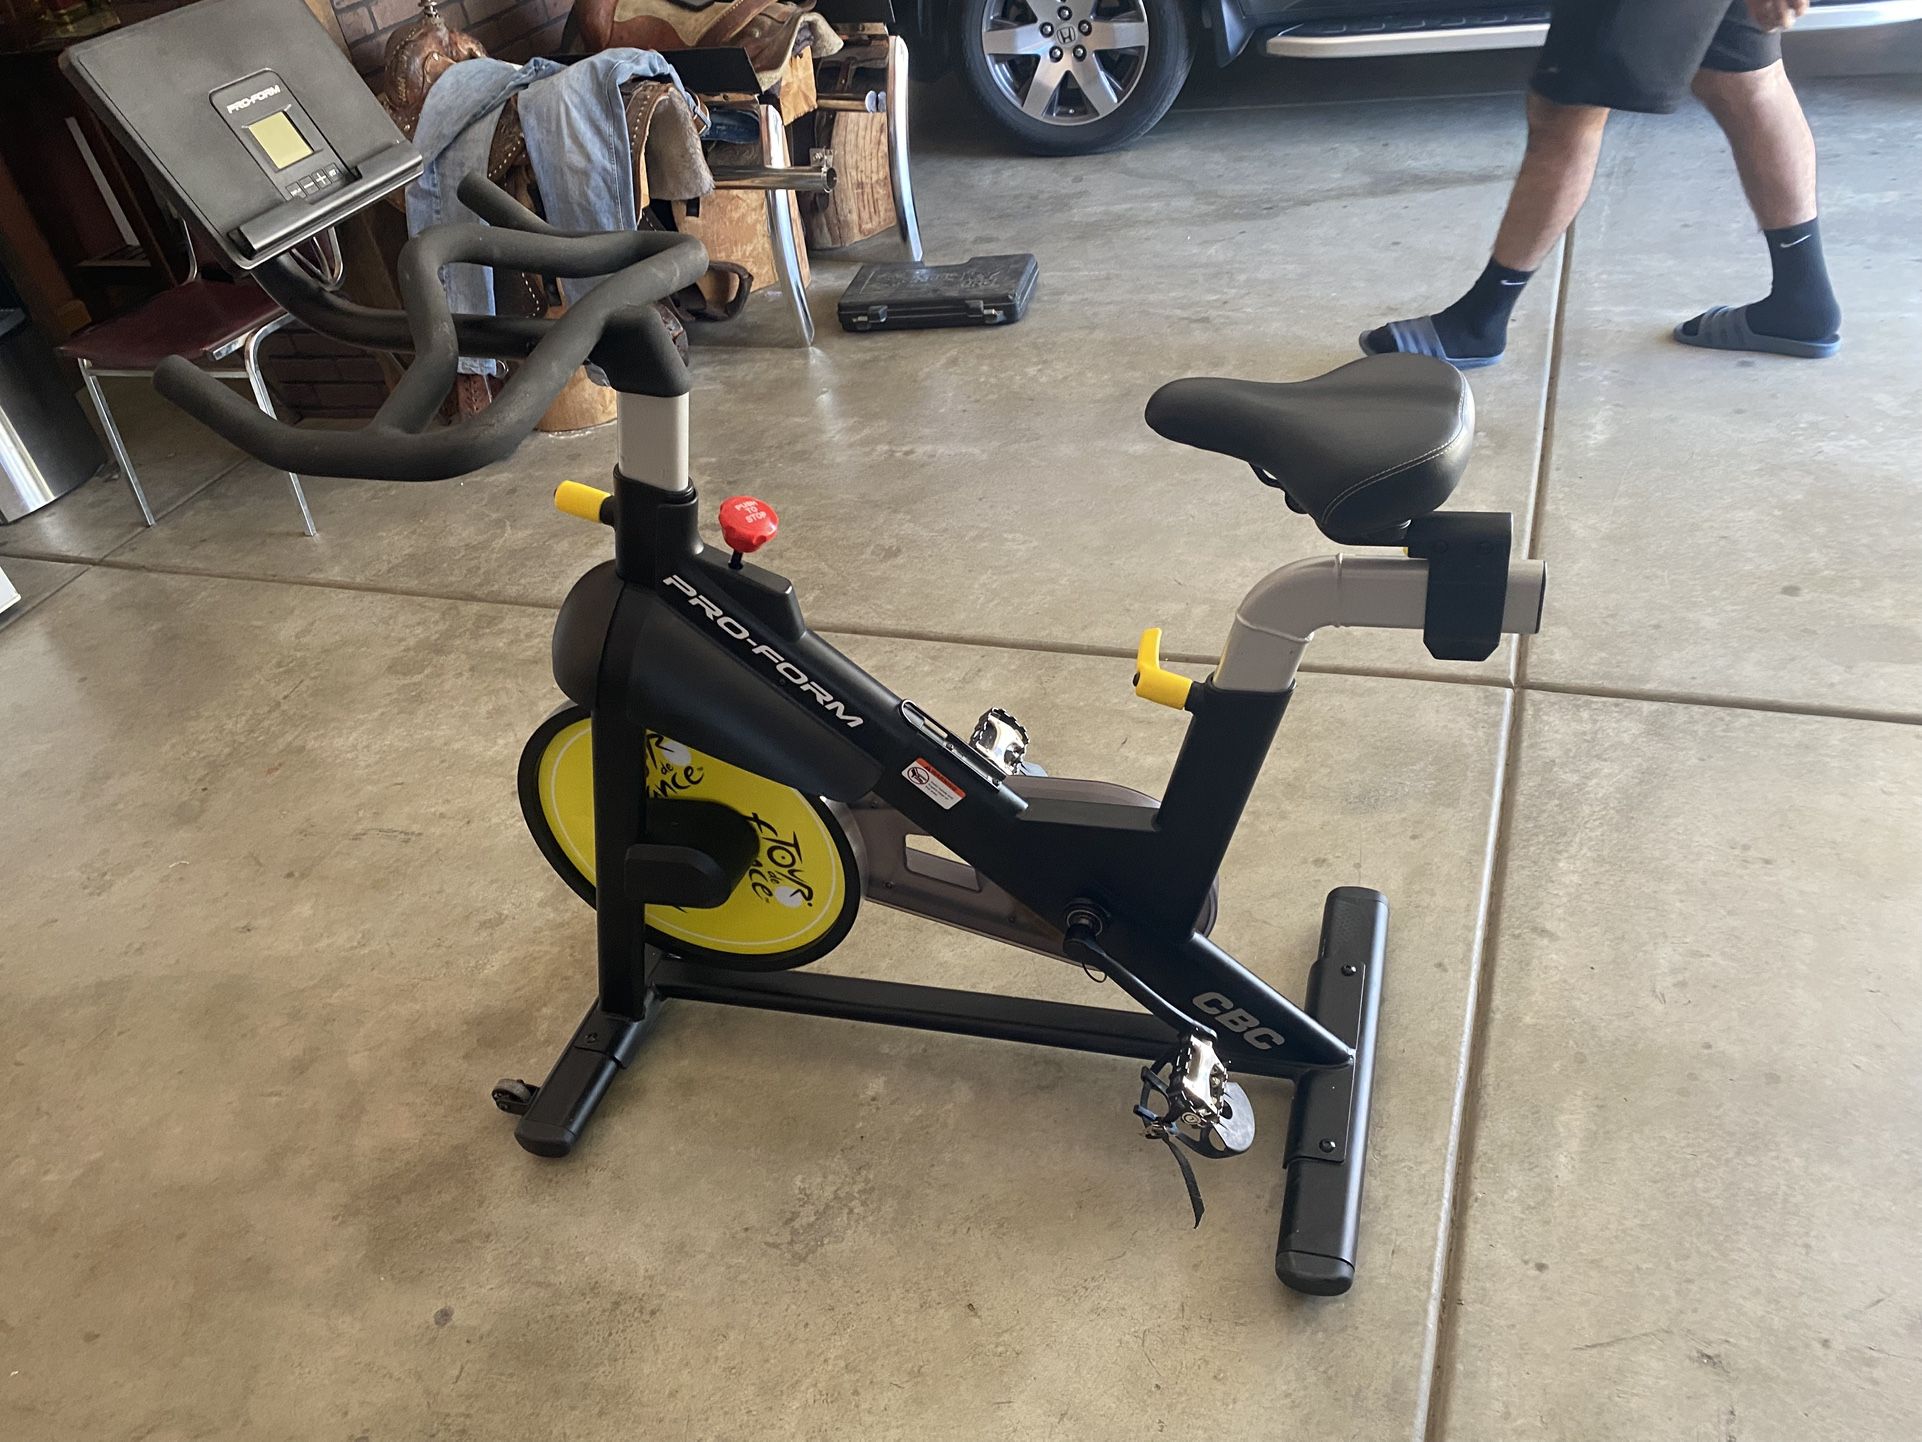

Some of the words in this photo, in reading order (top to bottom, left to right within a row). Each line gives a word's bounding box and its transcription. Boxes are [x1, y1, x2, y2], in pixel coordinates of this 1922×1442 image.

[227, 85, 281, 114] PRO-FORM
[745, 506, 758, 514] TO
[745, 511, 767, 523] STOP
[662, 574, 864, 728] PRO-FORM
[660, 760, 674, 775] de
[1191, 991, 1286, 1050] CBC
